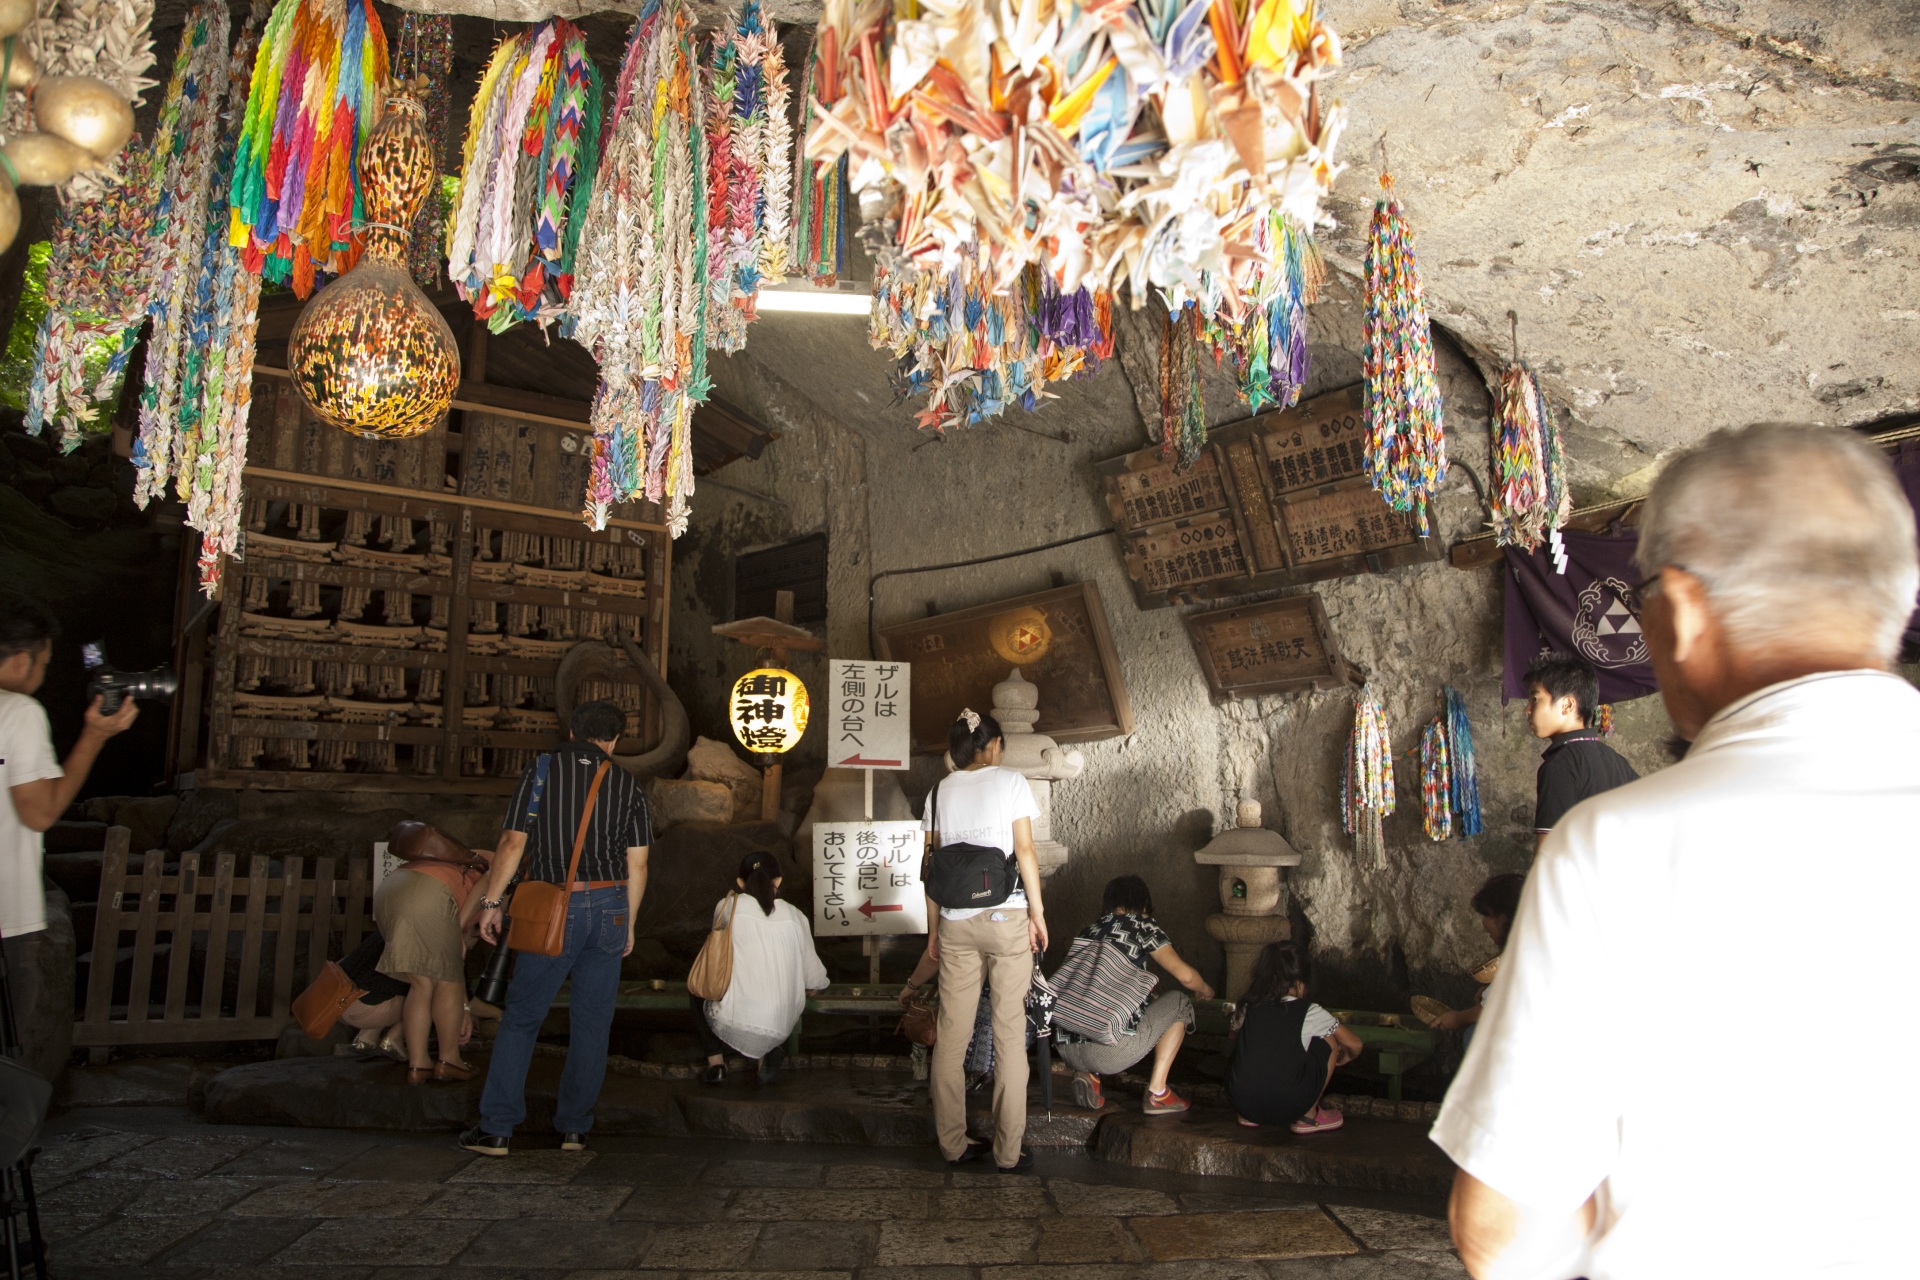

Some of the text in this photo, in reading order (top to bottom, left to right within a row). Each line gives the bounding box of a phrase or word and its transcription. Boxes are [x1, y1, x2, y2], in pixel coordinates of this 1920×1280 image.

[736, 674, 787, 749] 御神燈
[841, 664, 865, 747] 左側の台へ
[874, 665, 899, 717] ザルは
[823, 831, 850, 927] おいて下さい。
[856, 831, 880, 889] 後の台に
